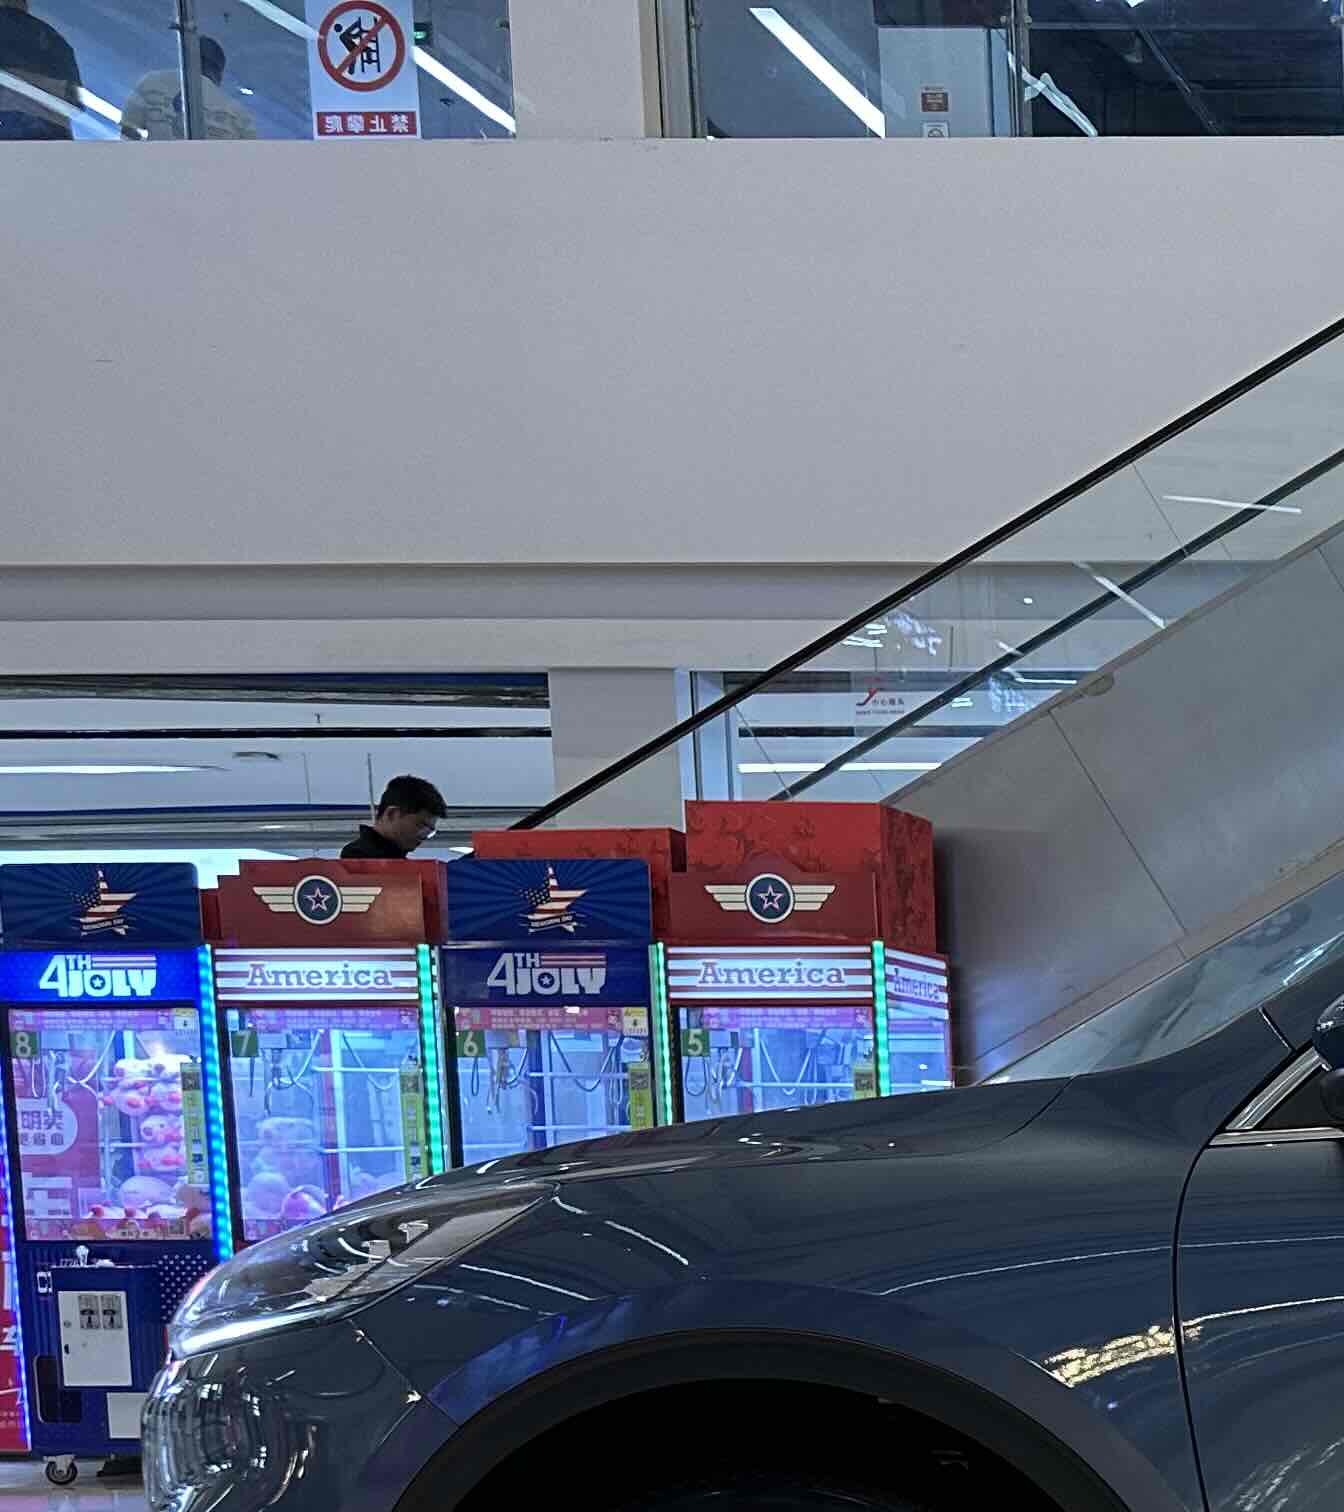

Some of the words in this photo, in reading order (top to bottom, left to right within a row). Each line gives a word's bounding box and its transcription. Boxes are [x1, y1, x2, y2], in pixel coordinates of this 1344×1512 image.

[247, 962, 393, 987] America
[698, 960, 846, 986] America
[15, 1032, 32, 1057] 8
[463, 1031, 479, 1056] 6
[687, 1030, 704, 1056] 5
